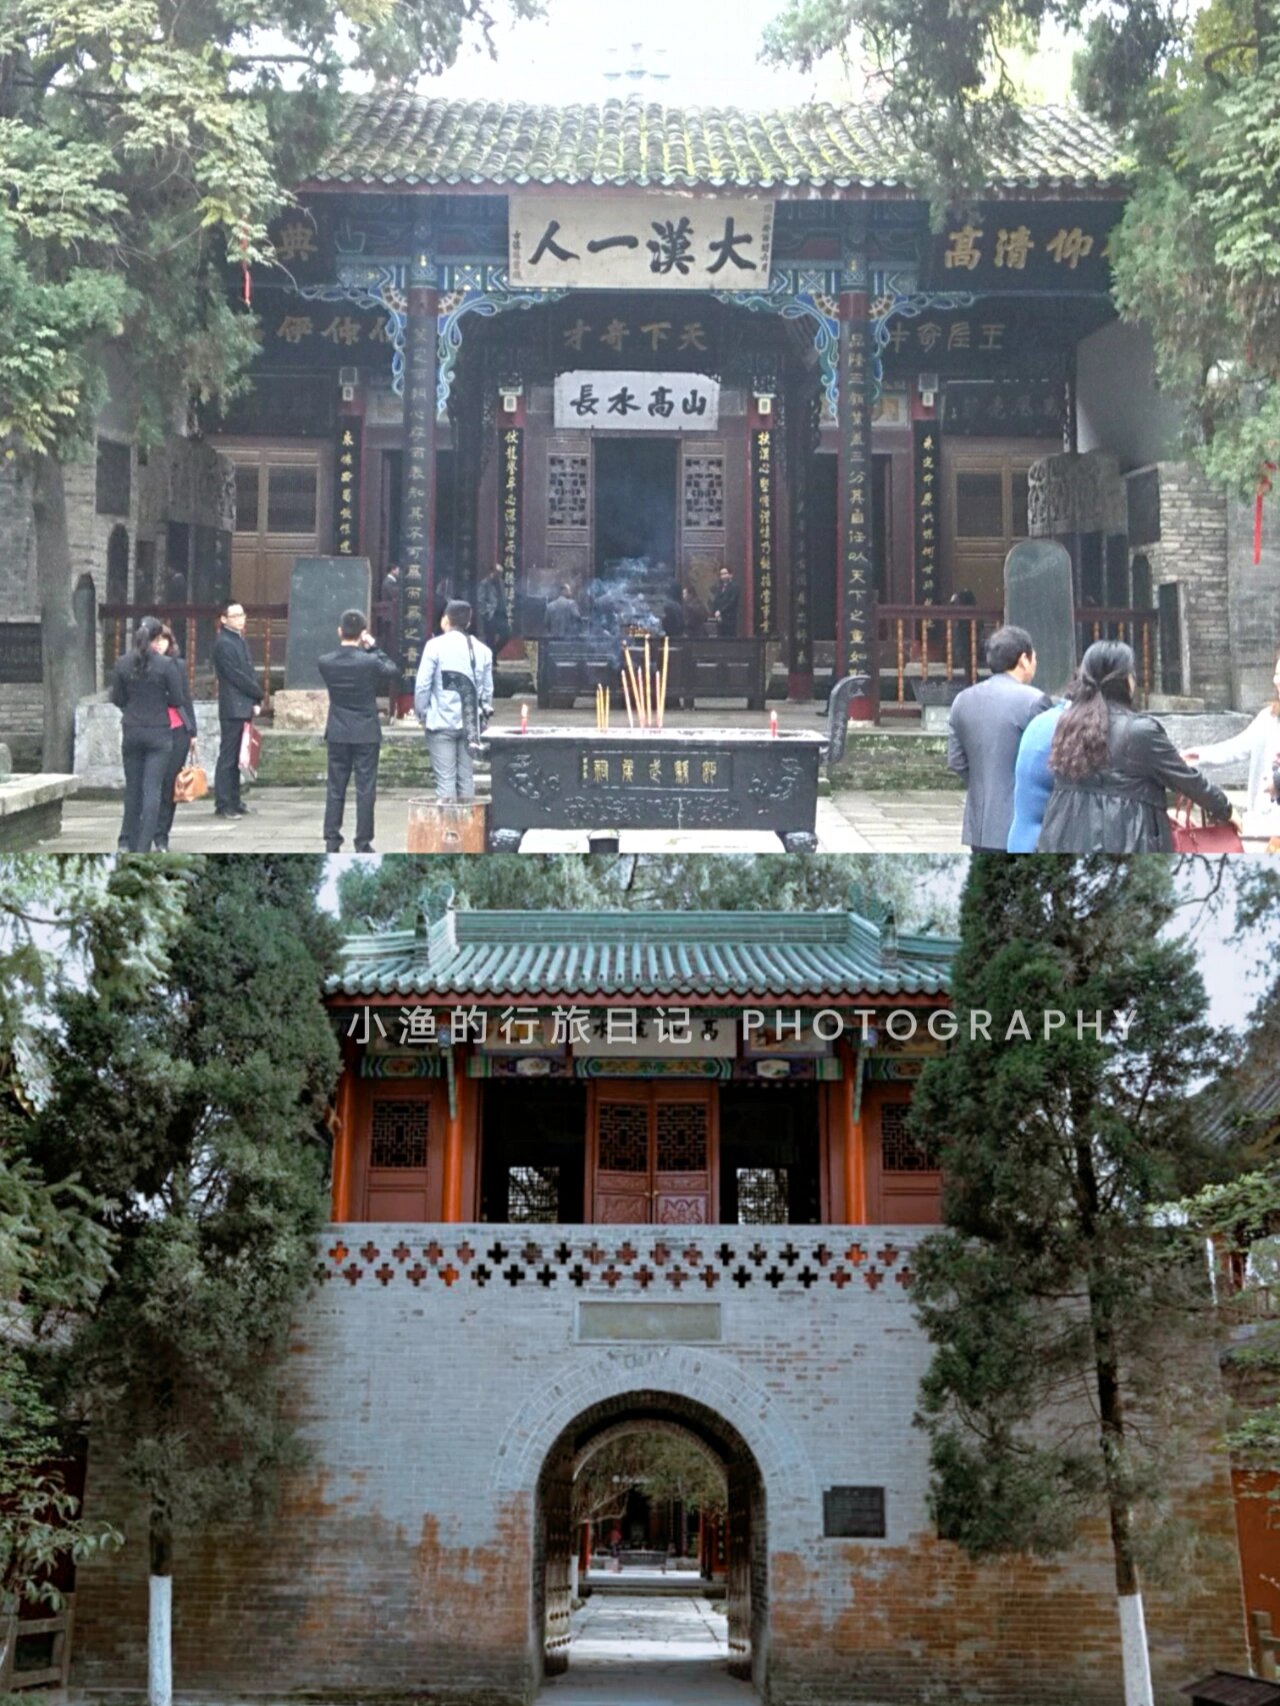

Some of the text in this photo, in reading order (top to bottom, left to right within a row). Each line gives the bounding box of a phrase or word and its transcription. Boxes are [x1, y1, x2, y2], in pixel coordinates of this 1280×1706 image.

[528, 216, 757, 275] 大漢一人
[944, 225, 1118, 270] 仰清高
[563, 318, 708, 352] 天下奇才
[570, 384, 707, 417] 山高水長
